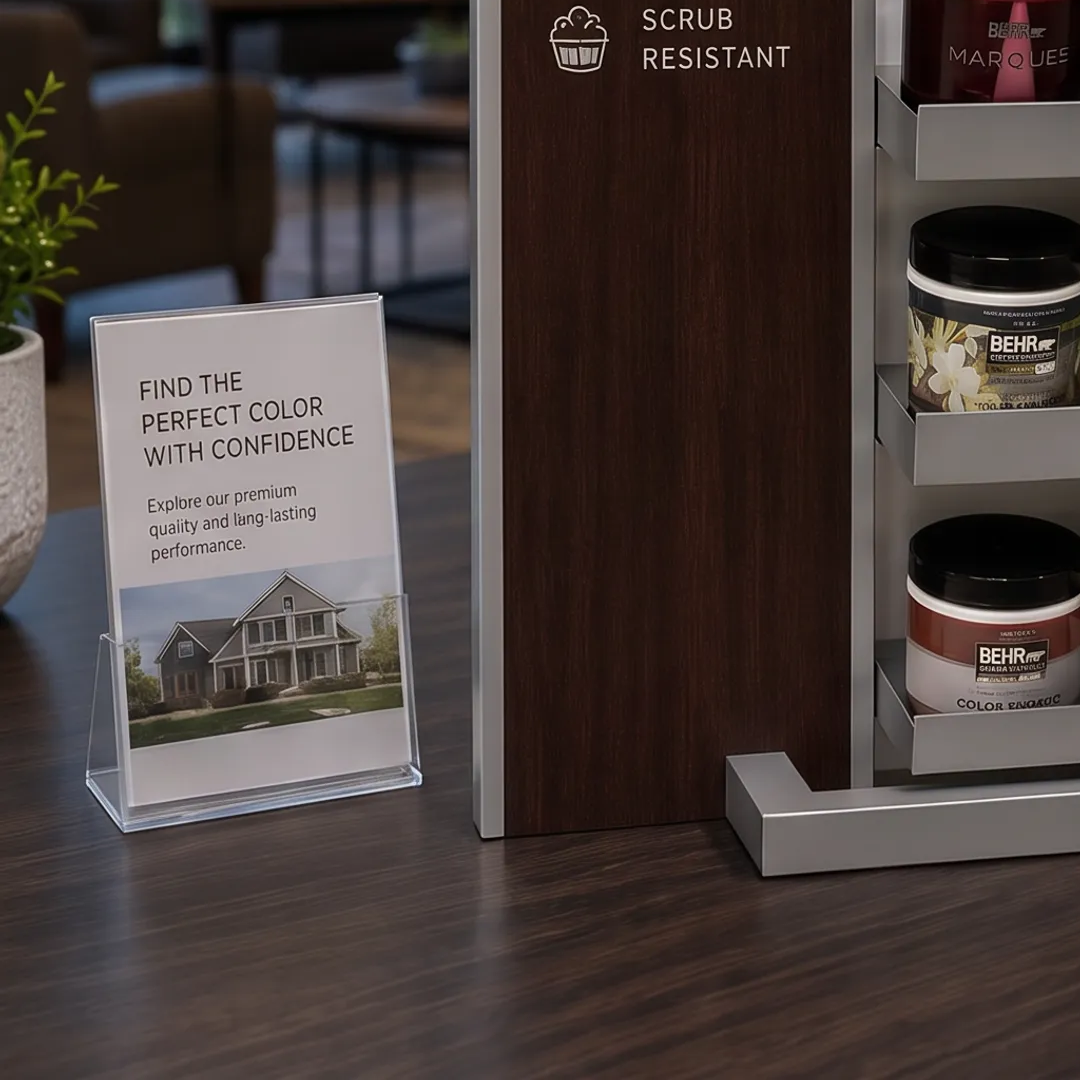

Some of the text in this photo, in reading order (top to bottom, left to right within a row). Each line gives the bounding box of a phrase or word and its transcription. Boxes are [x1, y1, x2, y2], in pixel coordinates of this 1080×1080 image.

[642, 8, 734, 31] SCRUB
[643, 46, 791, 70] RESISTANT
[990, 334, 1038, 353] BEHR
[139, 371, 243, 401] FIND THE
[142, 396, 323, 434] PERFECT COLOR
[144, 424, 355, 467] WITH CONFIDENCE
[147, 484, 297, 514] Explore our premium
[149, 520, 198, 540] quality
[202, 513, 229, 530] and
[151, 538, 246, 563] performance.
[979, 647, 1026, 665] BEHR
[956, 698, 1003, 711] COLOR
